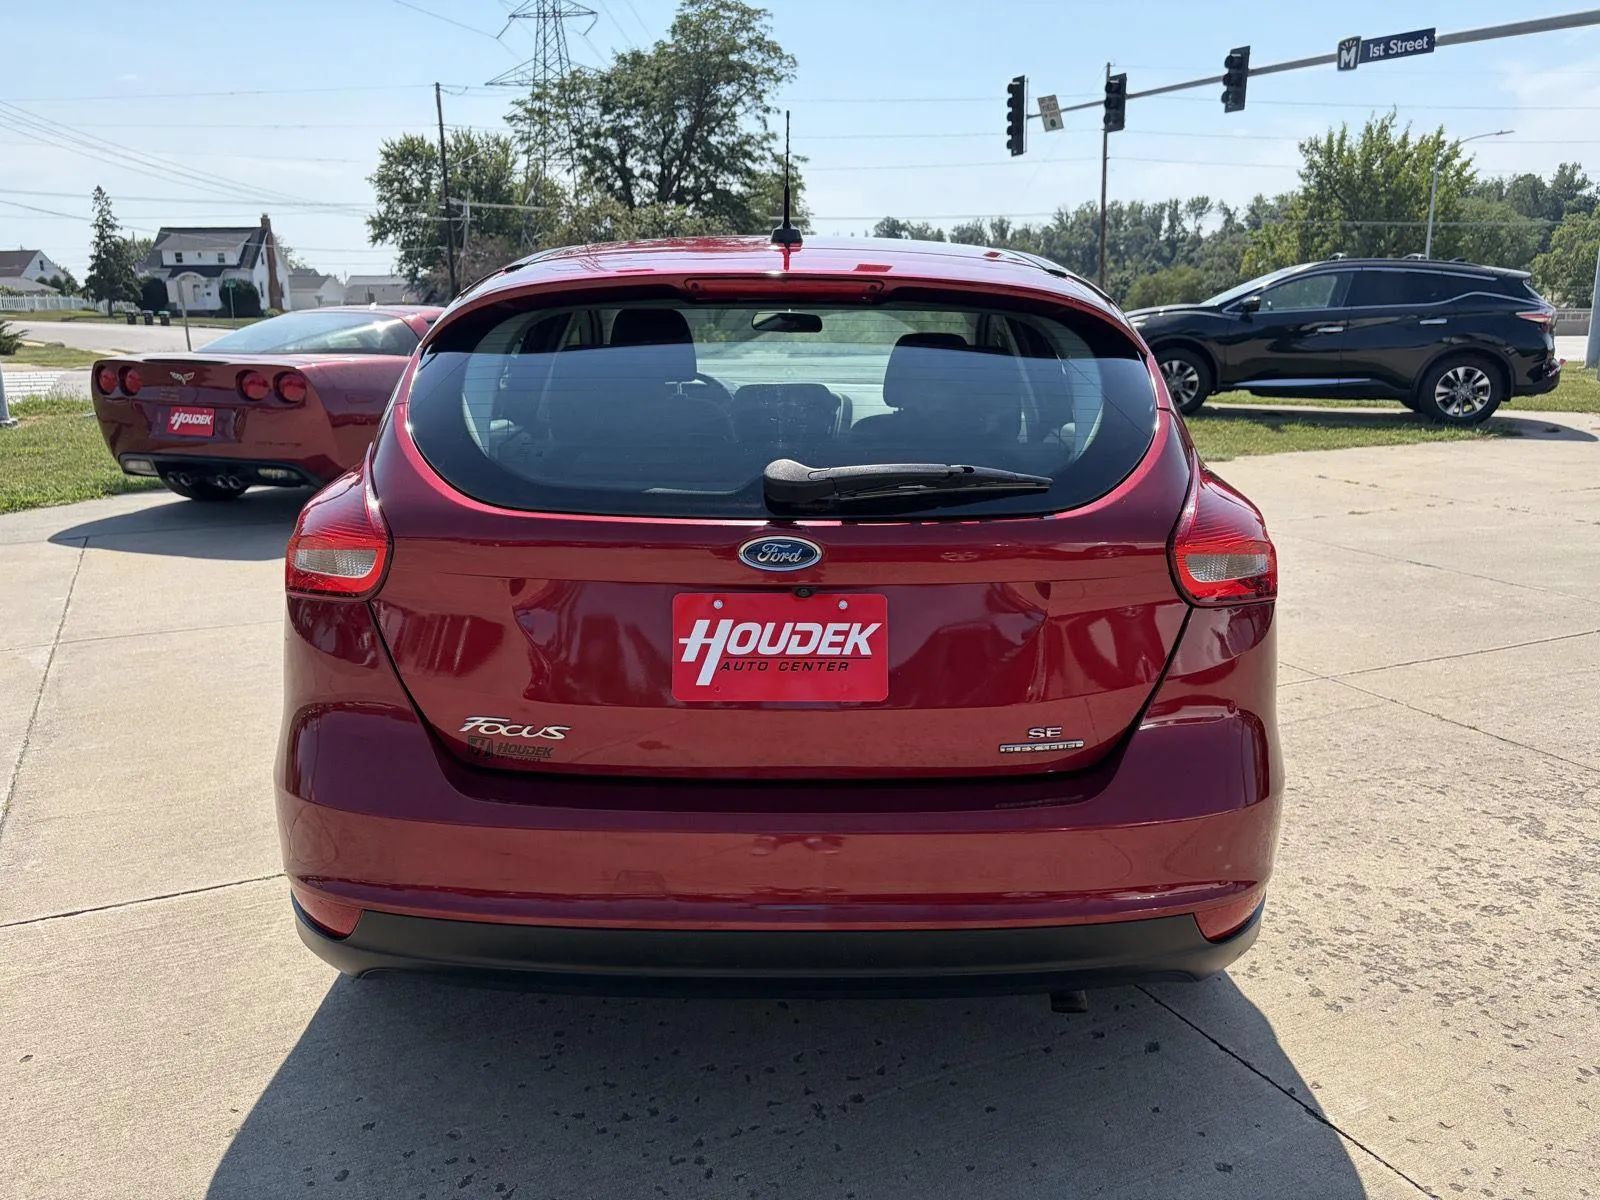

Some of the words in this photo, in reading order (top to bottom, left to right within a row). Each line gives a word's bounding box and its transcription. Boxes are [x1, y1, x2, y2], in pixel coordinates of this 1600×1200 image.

[1369, 43, 1385, 58] 1st
[1388, 35, 1429, 55] Street
[170, 411, 213, 431] HOUDEK
[757, 543, 803, 563] Ford
[678, 618, 883, 686] HOUDEK
[719, 661, 769, 672] AUTO
[778, 661, 849, 672] CENTER
[1028, 726, 1062, 739] SE
[495, 741, 555, 758] HOUDEK
